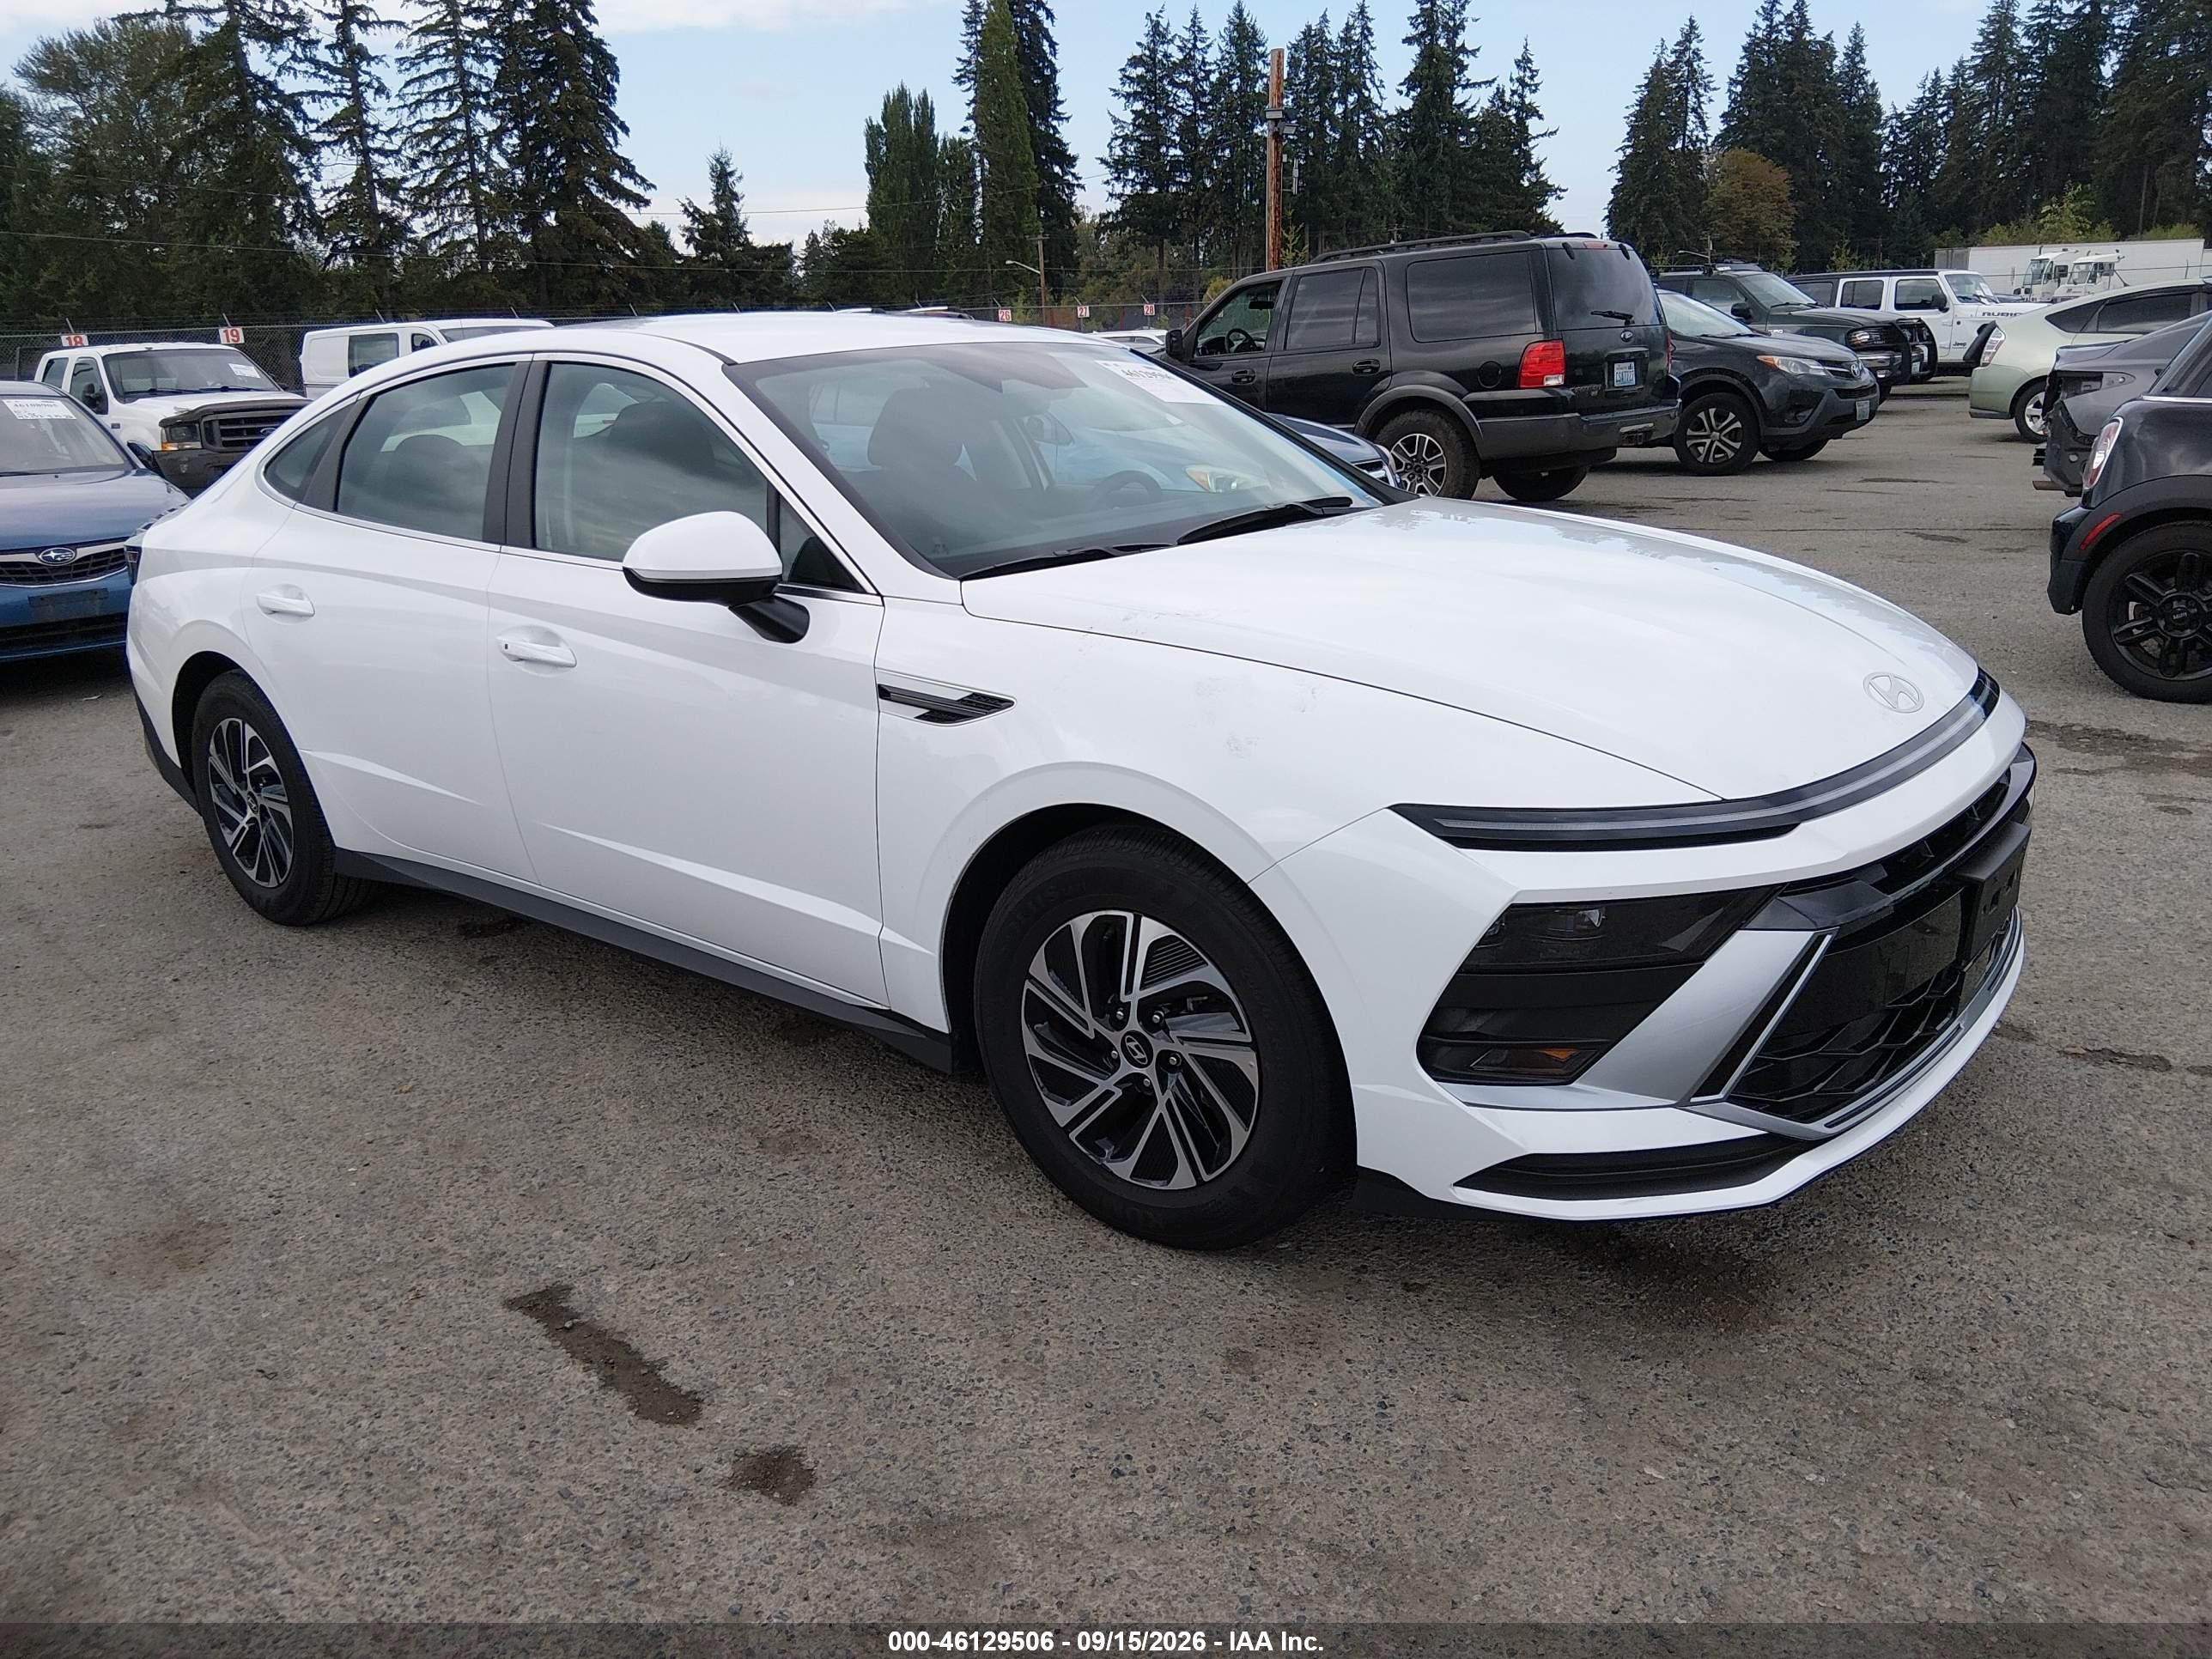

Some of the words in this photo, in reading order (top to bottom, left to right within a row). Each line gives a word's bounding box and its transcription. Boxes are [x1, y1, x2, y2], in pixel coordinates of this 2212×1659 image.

[1000, 310, 1011, 321] 26
[1079, 307, 1088, 317] 27
[1146, 306, 1154, 315] 28
[223, 328, 240, 343] 19
